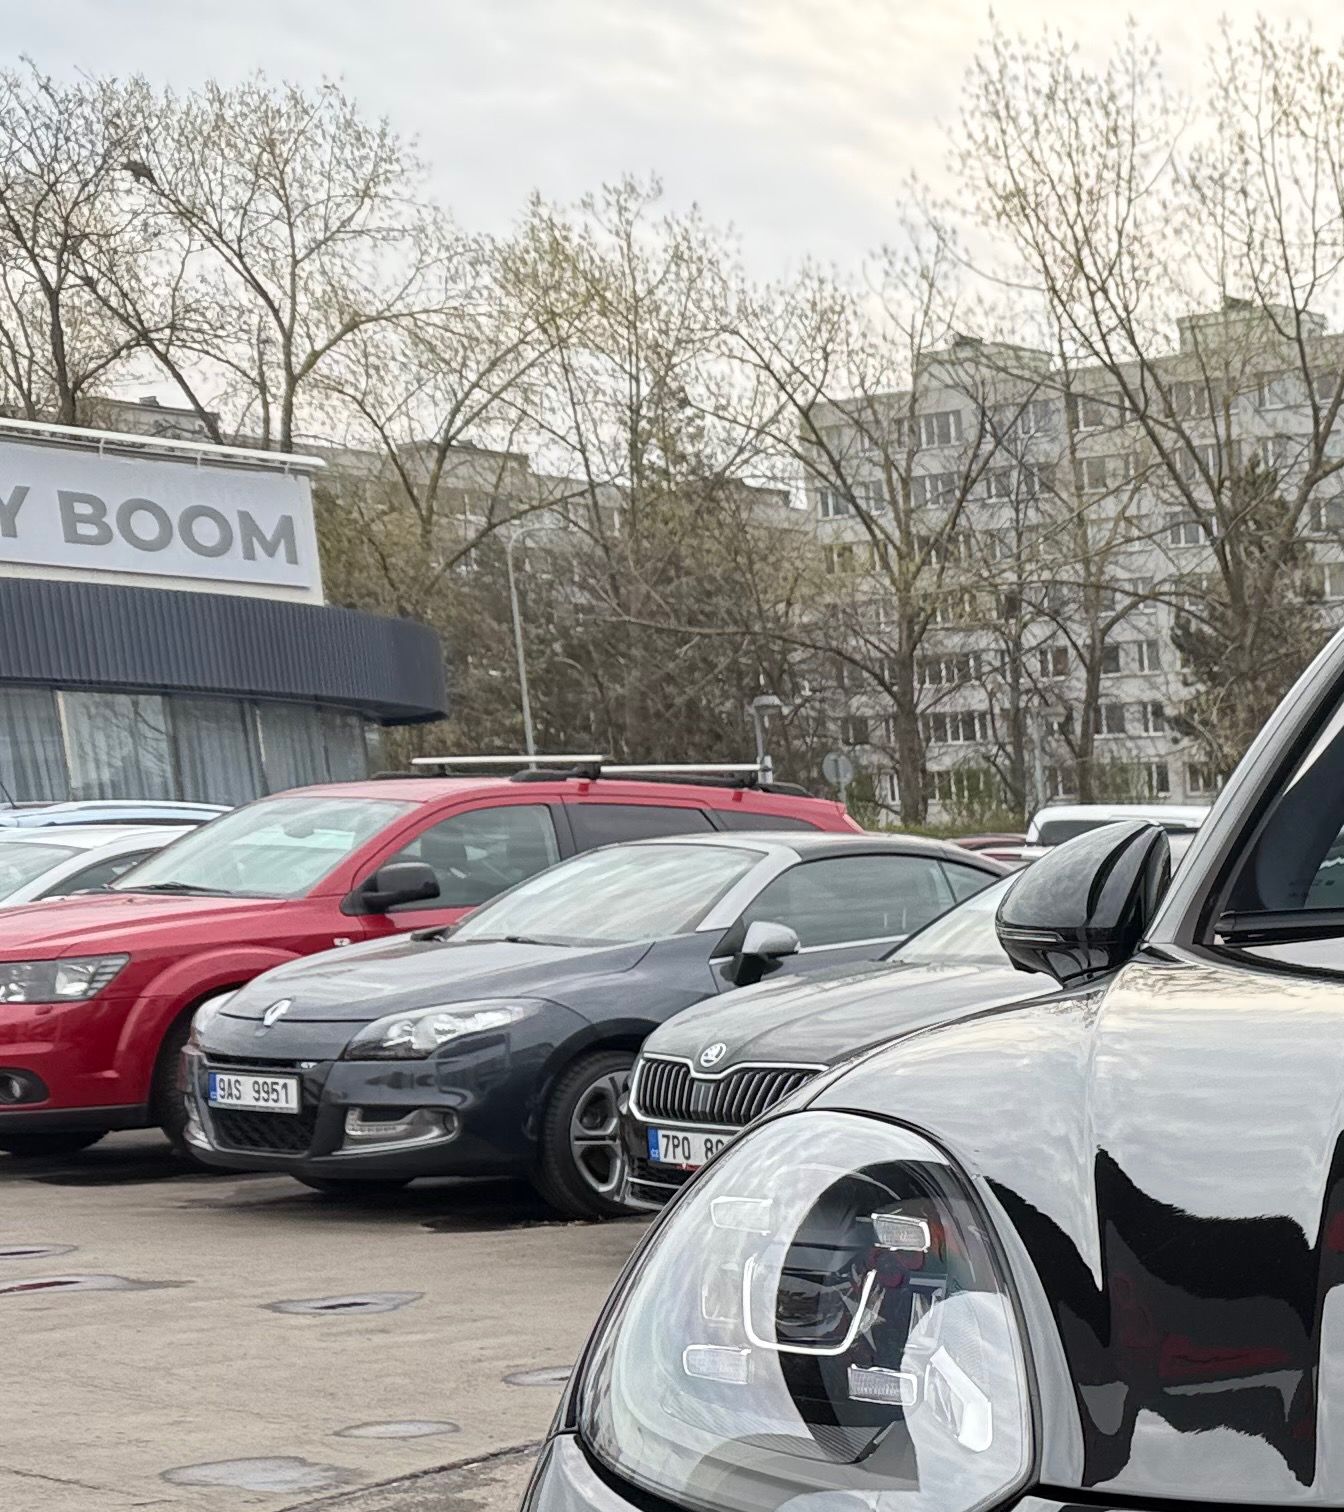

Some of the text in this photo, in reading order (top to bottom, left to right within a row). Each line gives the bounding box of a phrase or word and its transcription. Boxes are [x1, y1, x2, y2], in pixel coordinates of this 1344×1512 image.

[57, 490, 299, 565] BOOM
[218, 1078, 290, 1104] 9AS 9951
